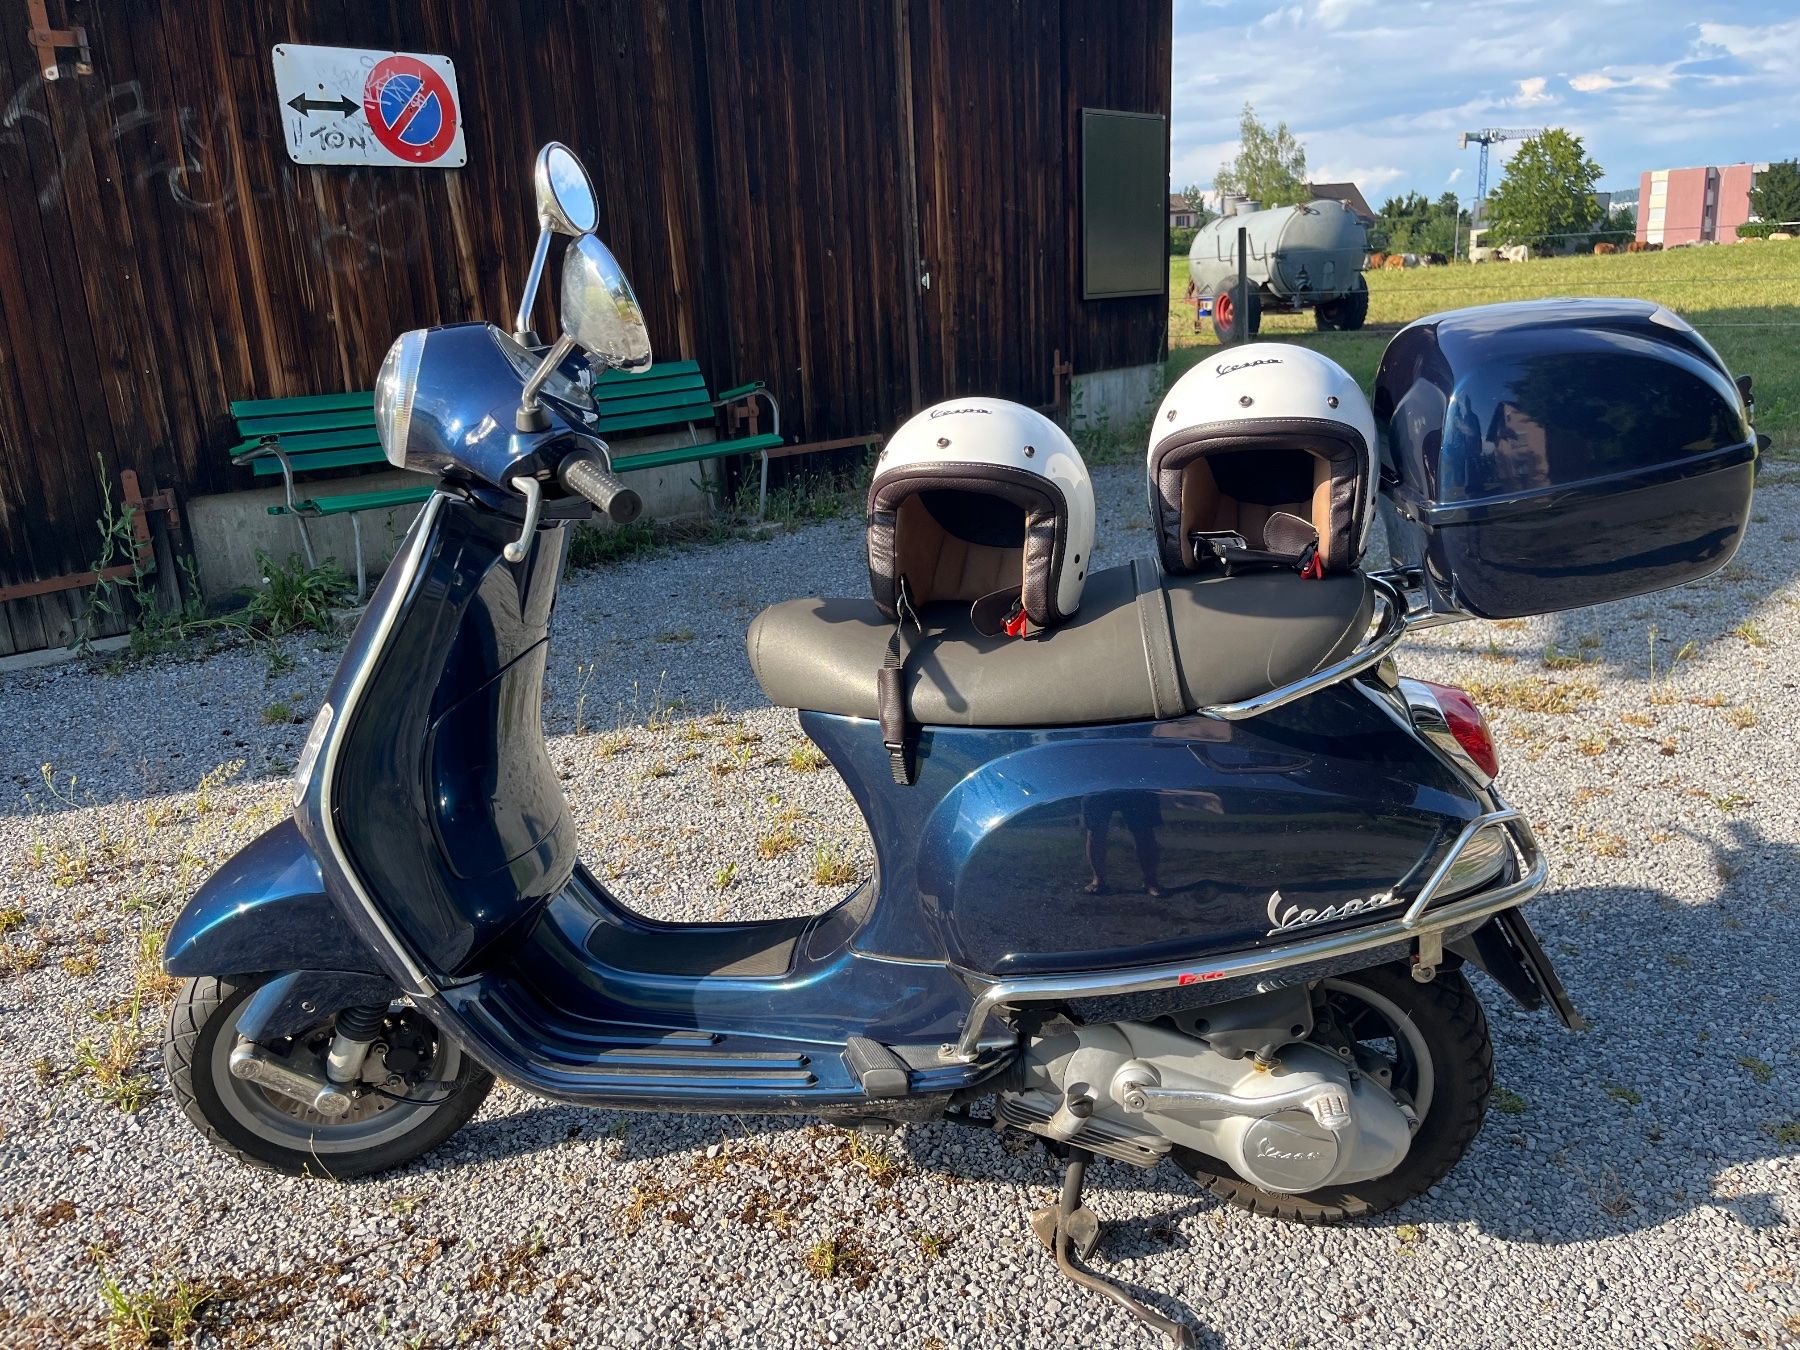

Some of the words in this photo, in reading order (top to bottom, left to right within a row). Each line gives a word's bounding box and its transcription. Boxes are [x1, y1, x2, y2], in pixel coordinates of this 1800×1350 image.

[1216, 359, 1283, 379] Vespa
[928, 408, 993, 421] Vespa
[1266, 889, 1405, 937] Vespa
[1257, 1137, 1321, 1160] Vespa
